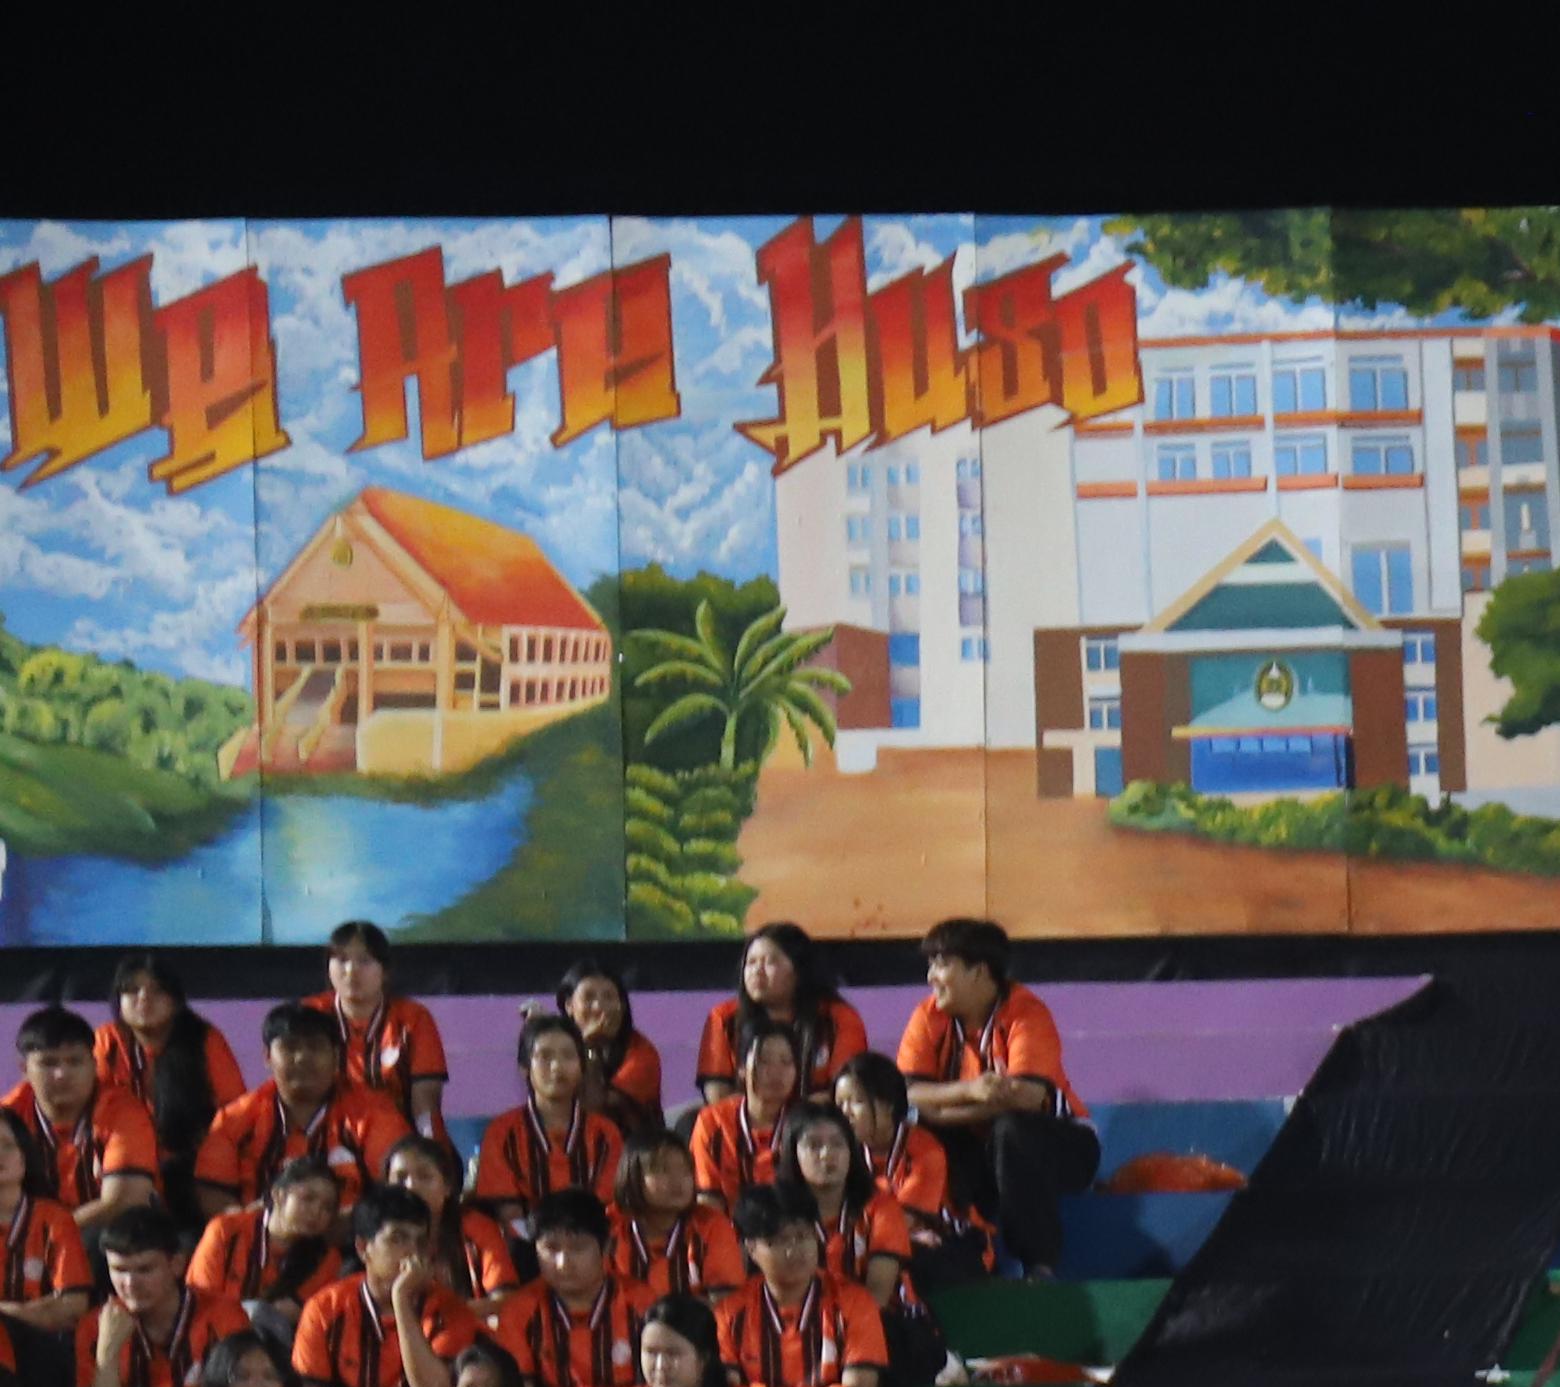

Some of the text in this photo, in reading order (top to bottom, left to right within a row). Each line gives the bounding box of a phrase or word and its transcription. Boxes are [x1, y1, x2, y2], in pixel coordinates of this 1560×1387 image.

[0, 214, 1147, 496] We Are Huso
